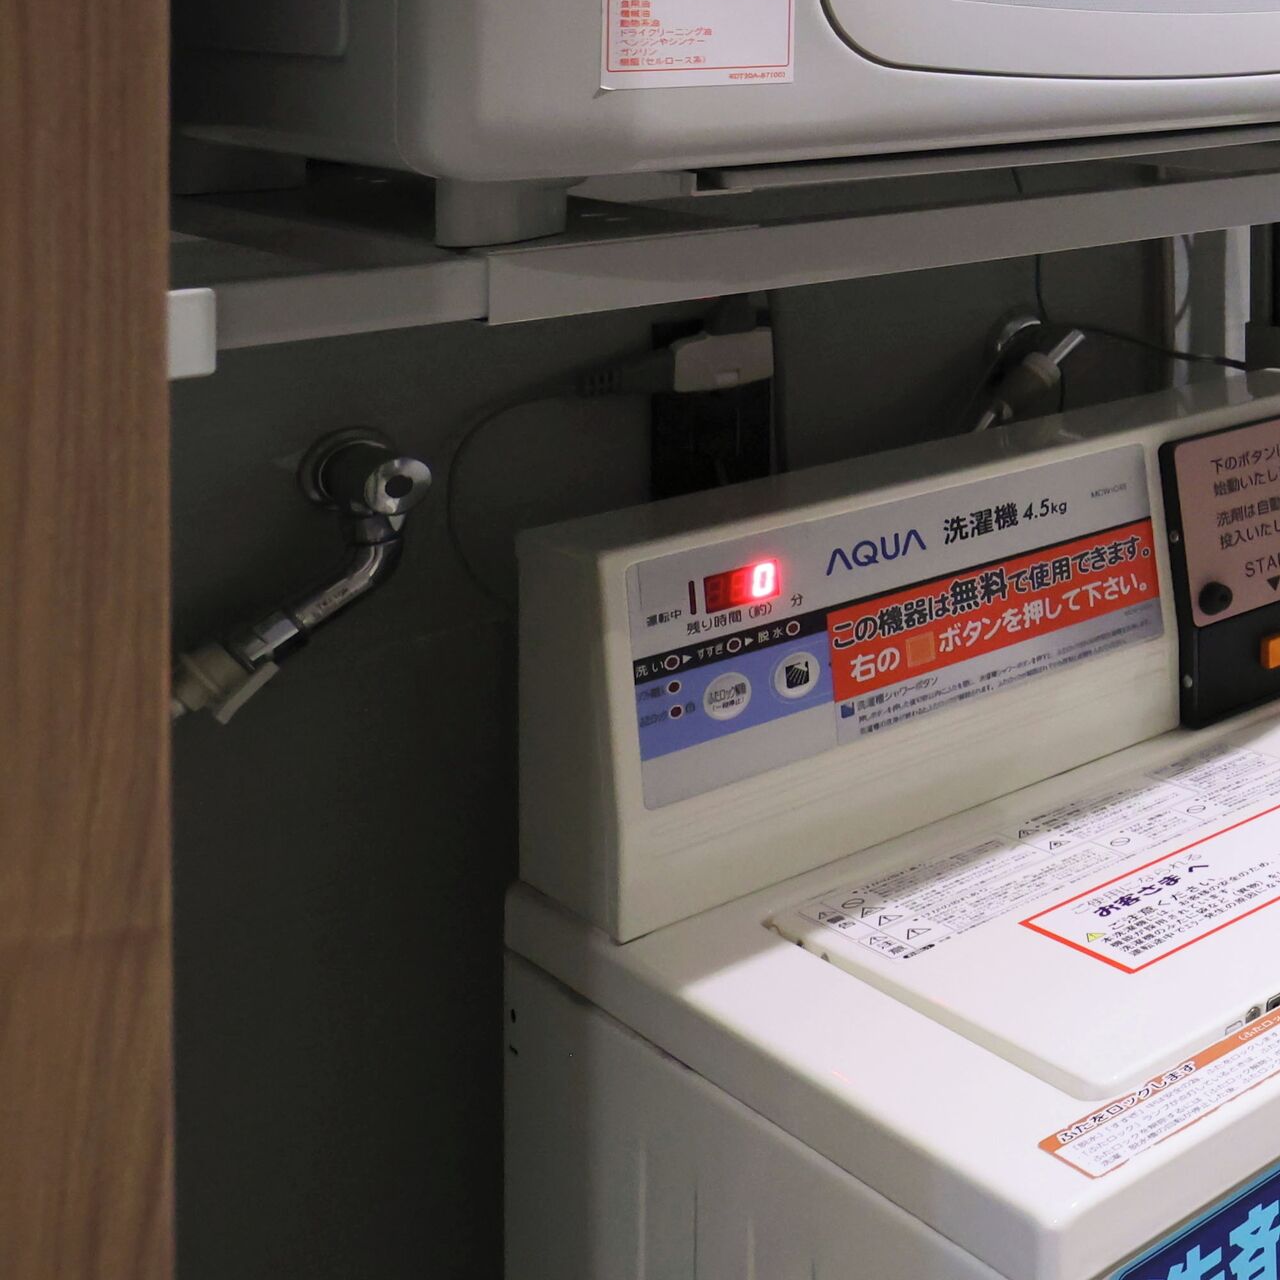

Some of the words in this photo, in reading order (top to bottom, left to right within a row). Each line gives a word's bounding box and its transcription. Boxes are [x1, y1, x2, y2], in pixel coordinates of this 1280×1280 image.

[825, 529, 926, 576] AQUA
[943, 503, 1018, 545] 洗濯機
[1022, 498, 1068, 521] 4.5kg
[752, 562, 774, 597] 0
[832, 535, 1151, 650] この機器は無料で使用できます。
[646, 610, 682, 626] 運転中
[791, 594, 803, 607] 分
[687, 603, 772, 635] 残り時間（約）
[758, 628, 783, 643] 脱水
[850, 646, 901, 683] 右の
[938, 574, 1148, 653] ボタンを押して下さい。
[1058, 1062, 1197, 1144] ふたをロックします
